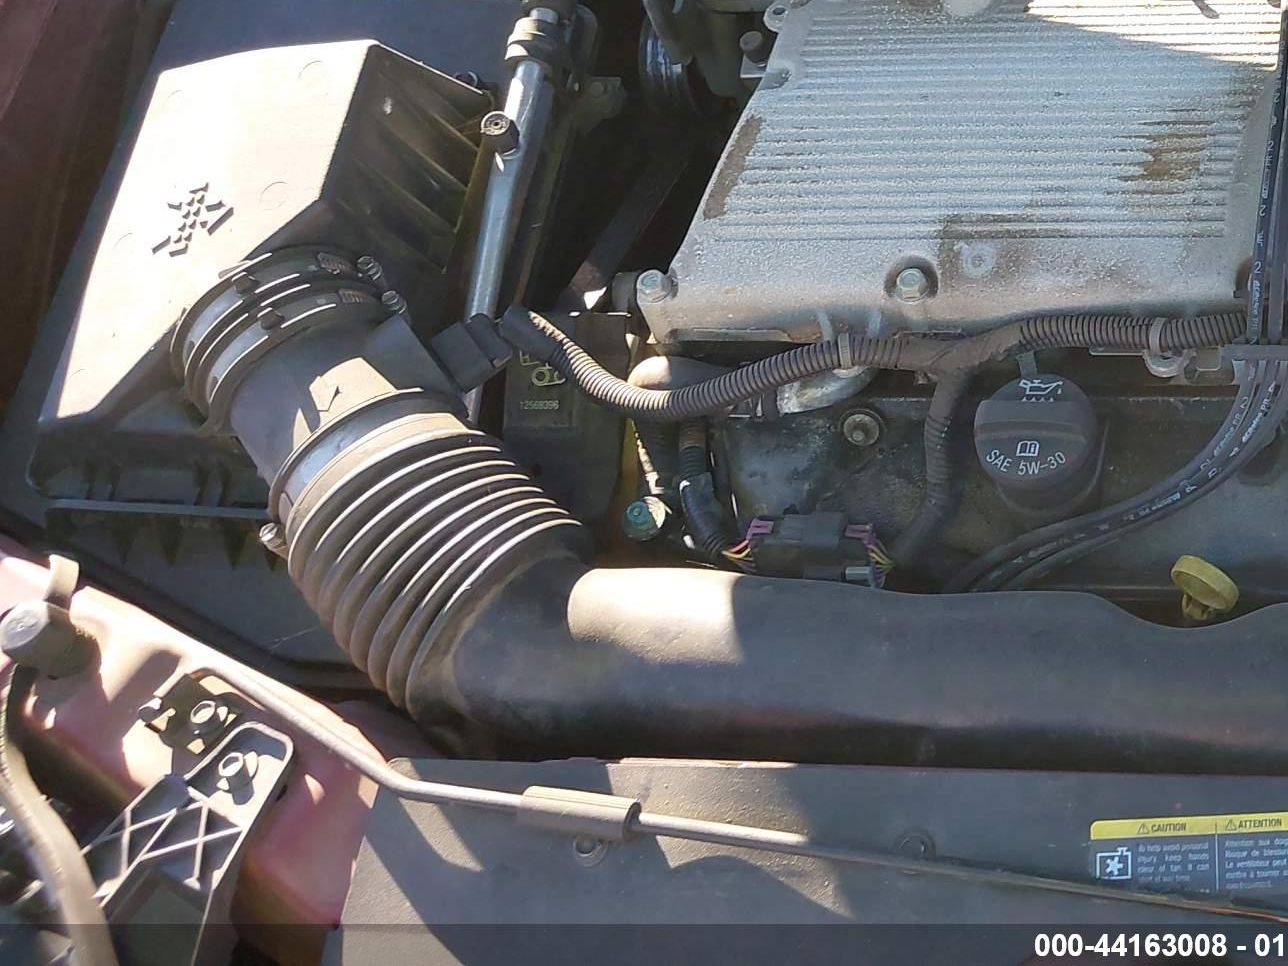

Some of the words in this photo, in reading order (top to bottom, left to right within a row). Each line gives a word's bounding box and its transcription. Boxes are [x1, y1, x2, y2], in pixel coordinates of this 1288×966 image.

[985, 449, 1013, 473] SAE
[1017, 451, 1067, 476] 5W-30
[1150, 822, 1187, 833] CAUTION
[1237, 818, 1283, 829] ATTENTION
